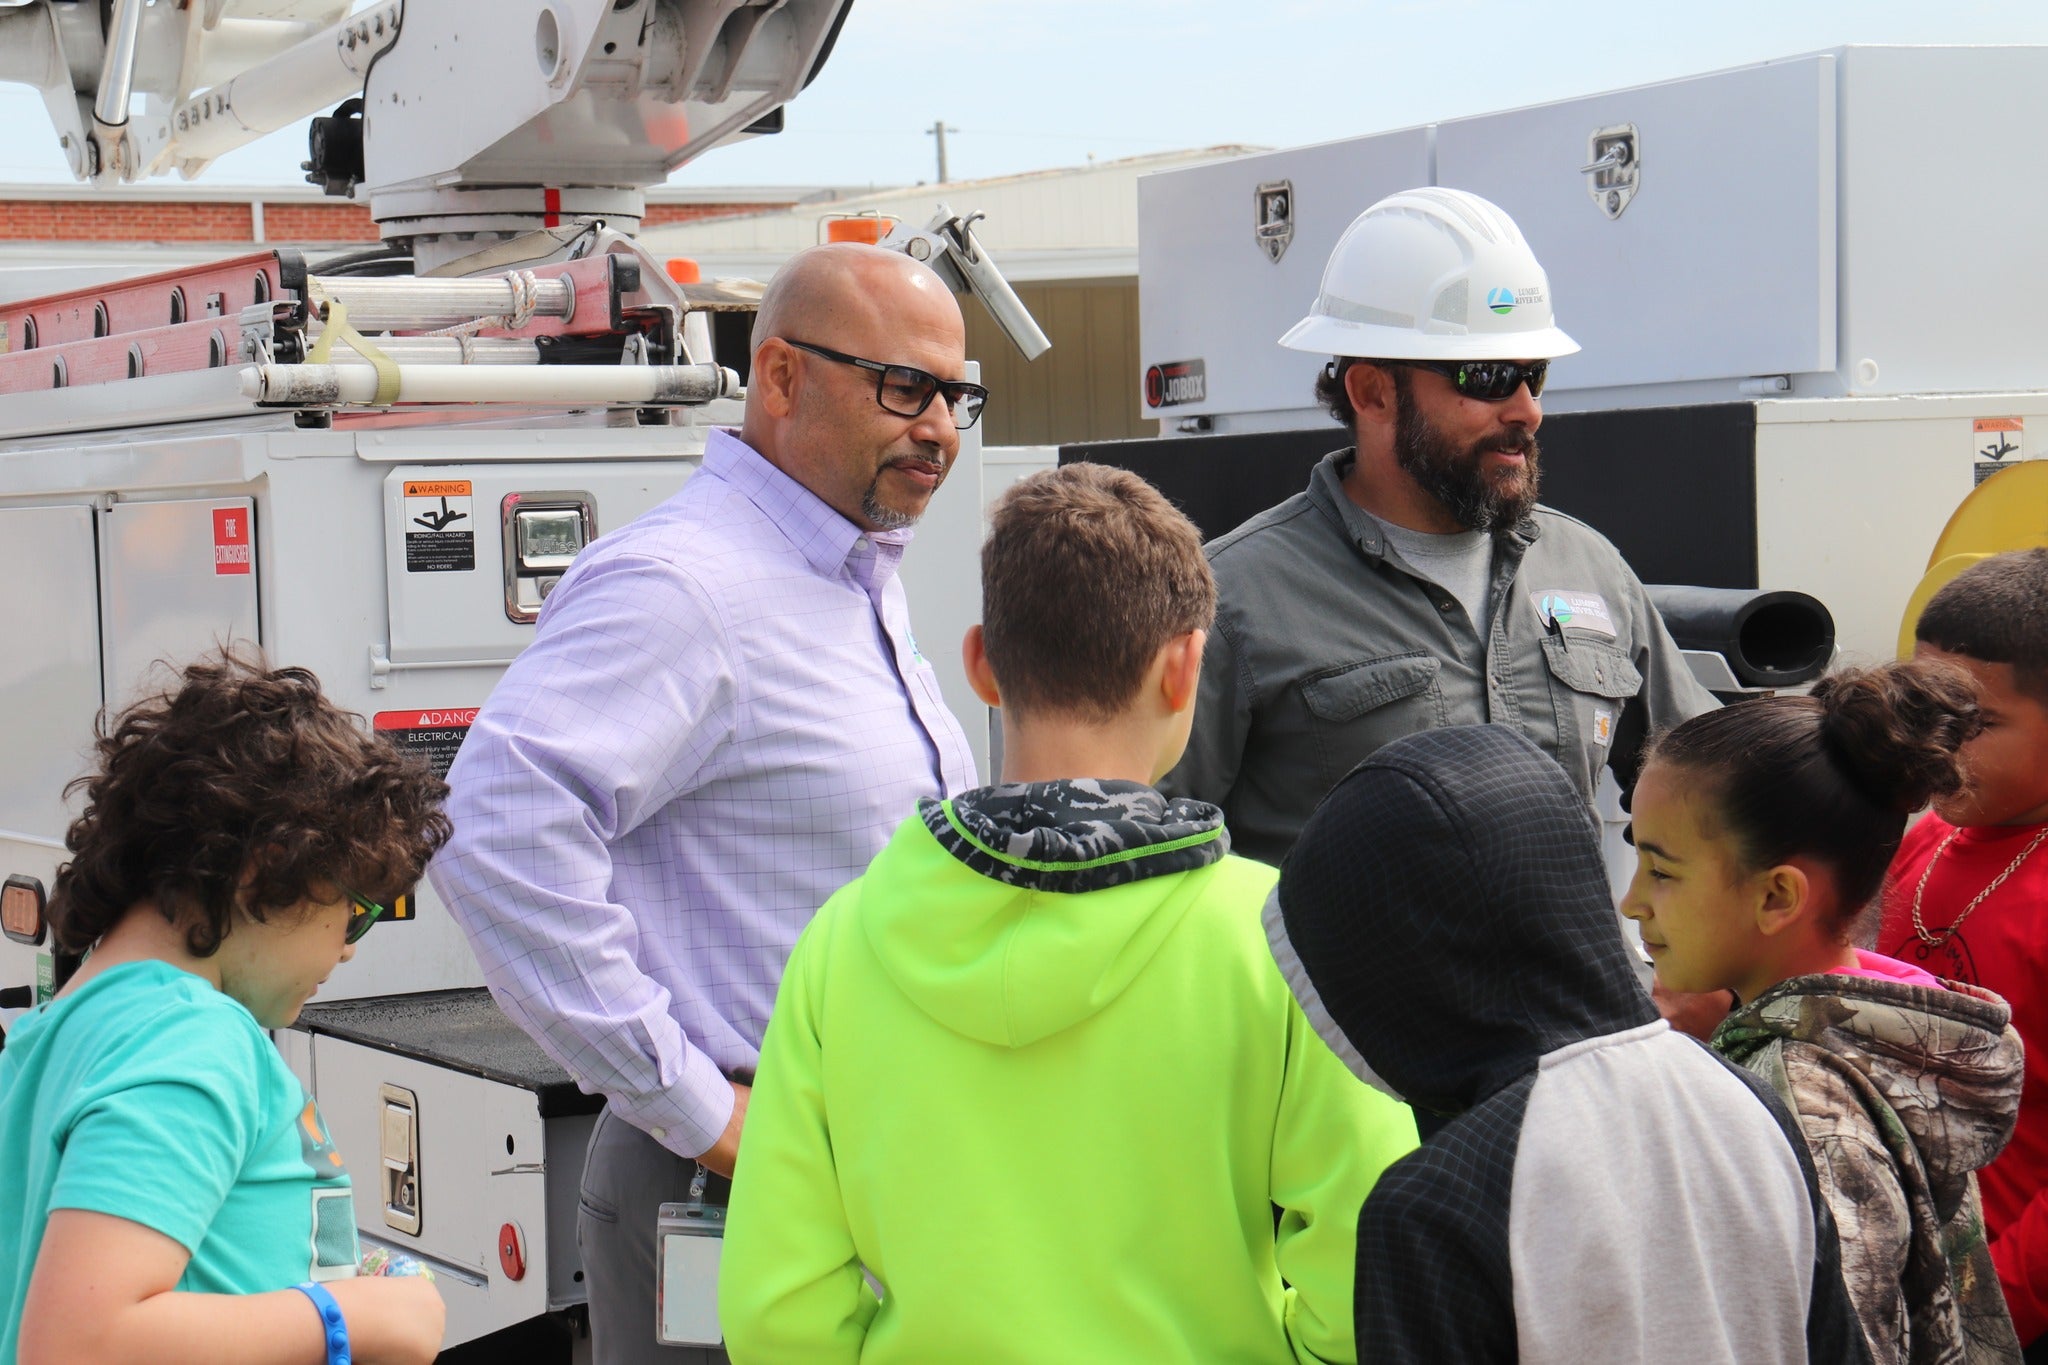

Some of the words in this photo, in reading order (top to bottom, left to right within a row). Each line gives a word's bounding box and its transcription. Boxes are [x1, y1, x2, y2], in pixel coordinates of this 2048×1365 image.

[1515, 296, 1533, 304] RIVER
[1165, 374, 1204, 402] JOBOX
[417, 484, 465, 494] WARNING
[226, 518, 236, 538] FIRE
[216, 544, 250, 564] EXTINGUISHER
[431, 711, 476, 725] DANG
[408, 731, 464, 742] ELECTRICAL
